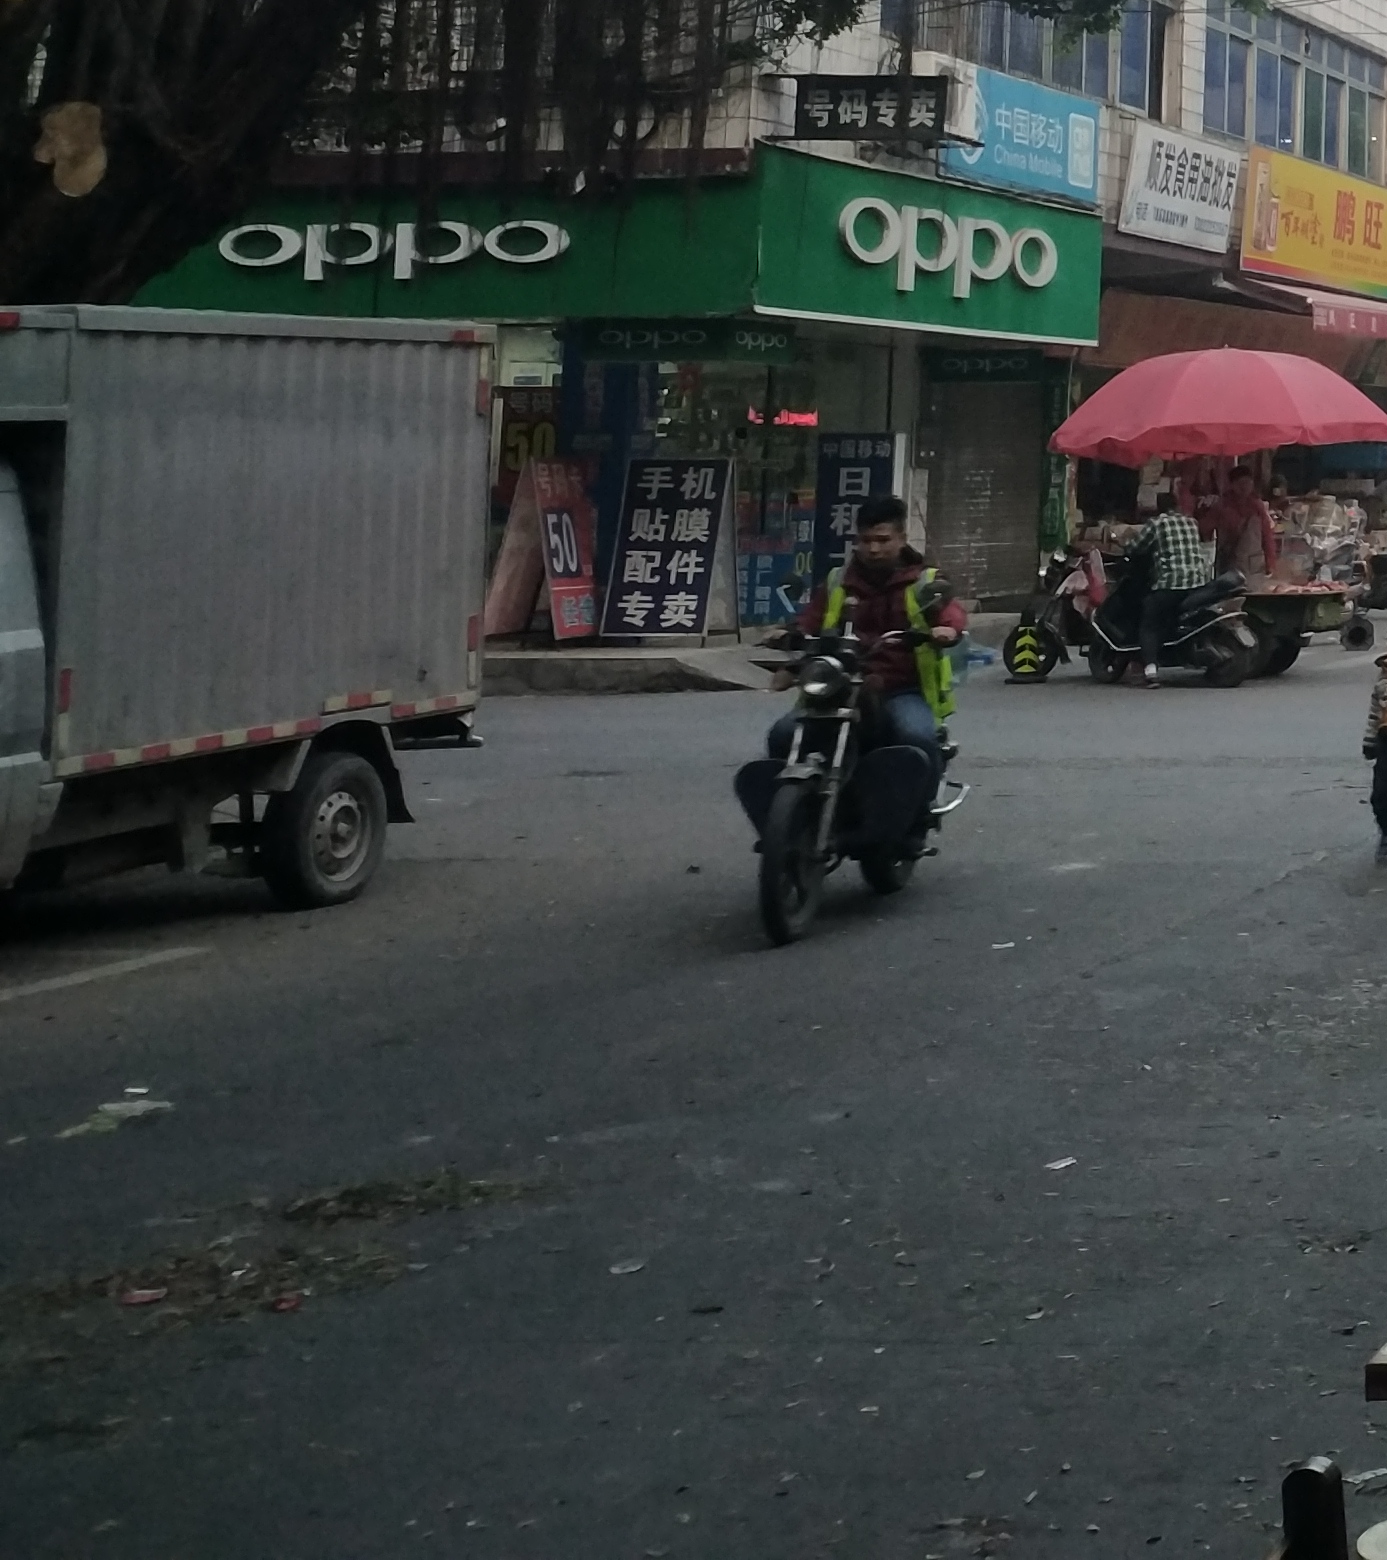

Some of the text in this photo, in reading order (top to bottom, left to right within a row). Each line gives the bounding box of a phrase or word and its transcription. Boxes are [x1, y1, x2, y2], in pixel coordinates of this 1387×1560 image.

[803, 88, 938, 129] 号码专卖
[995, 101, 1064, 155] 中国移动
[994, 143, 1027, 170] China
[1028, 152, 1063, 179] Mobile
[1145, 138, 1237, 212] 顺发食用油批发
[218, 220, 570, 281] oppo
[839, 197, 1058, 298] oppo
[736, 330, 787, 351] oppo
[637, 466, 718, 500] 手机
[547, 512, 578, 574] 50
[628, 507, 712, 543] 贴膜
[622, 549, 705, 585] 配件
[617, 590, 699, 628] 专卖
